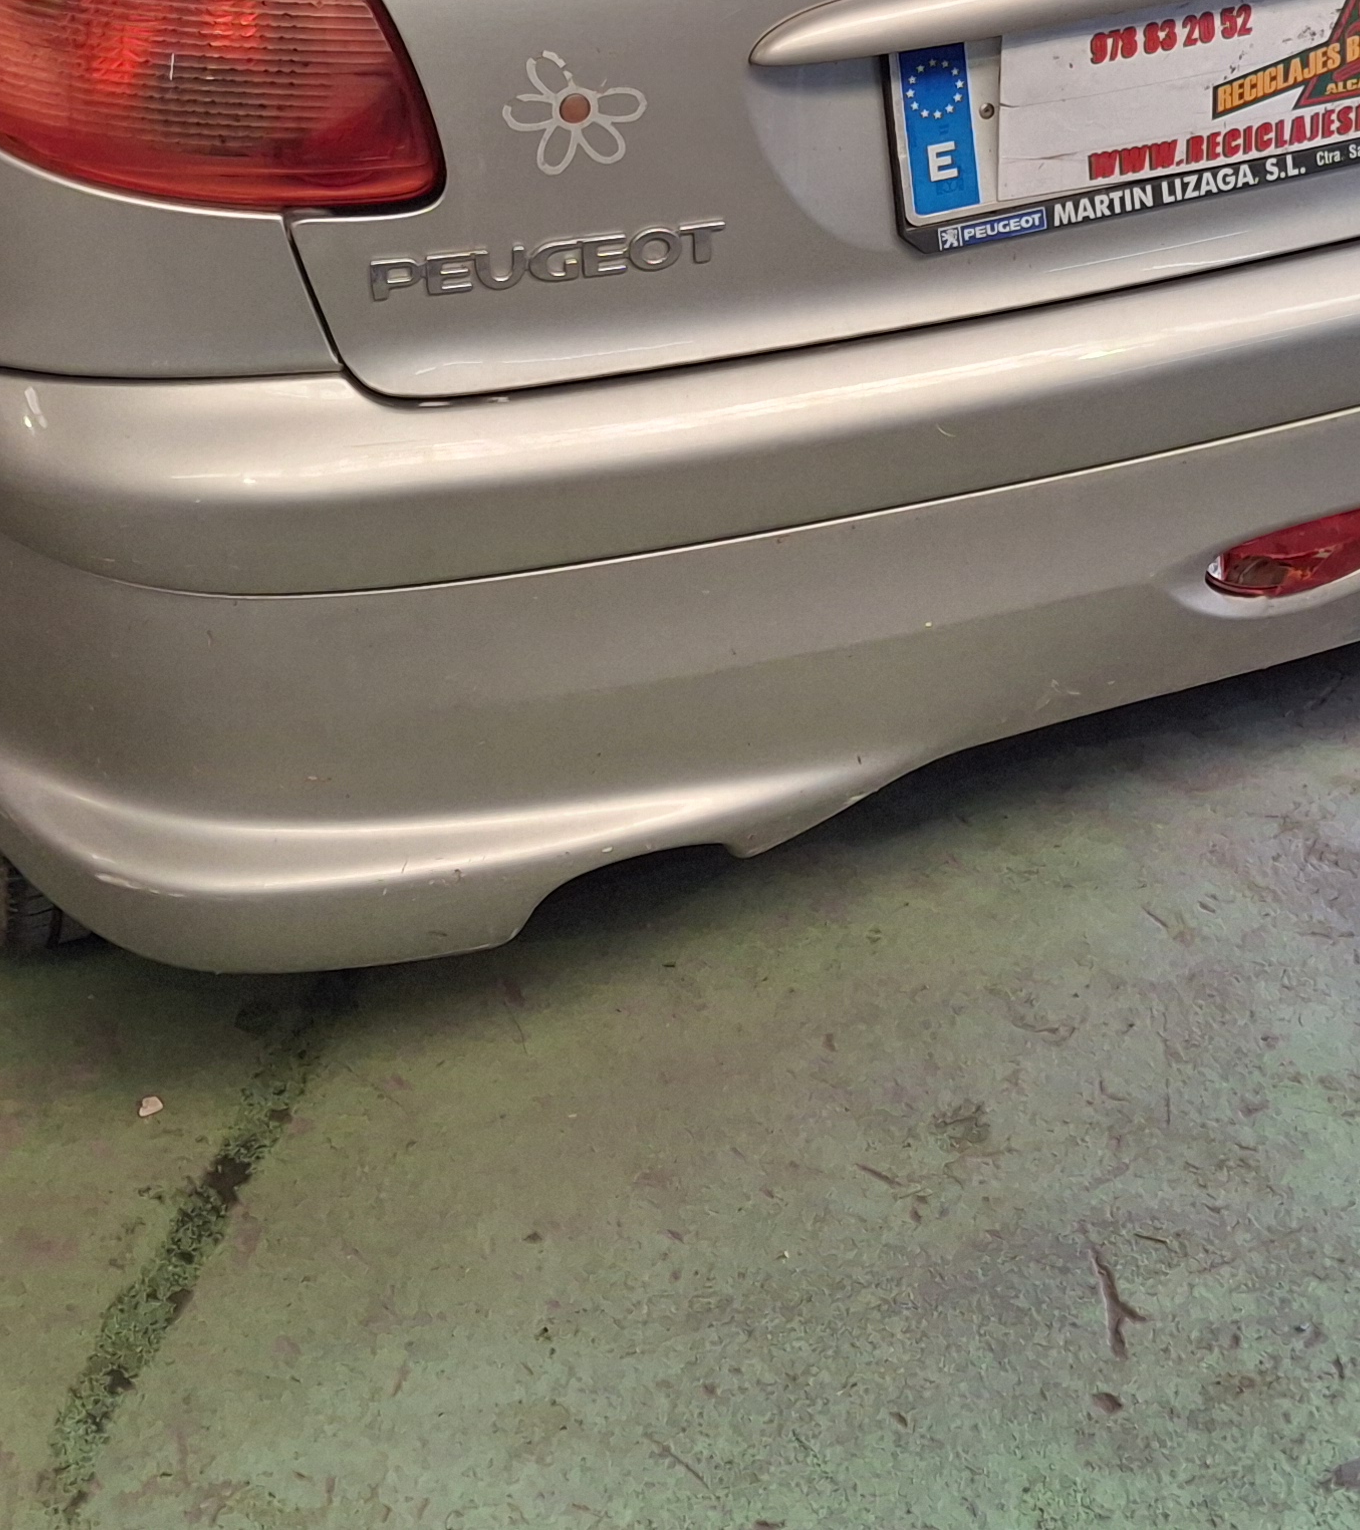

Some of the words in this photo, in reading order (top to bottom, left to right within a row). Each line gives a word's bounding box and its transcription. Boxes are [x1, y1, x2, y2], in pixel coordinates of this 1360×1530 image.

[1090, 26, 1138, 64] 978
[1143, 18, 1178, 55] 83
[1182, 11, 1216, 48] 20
[1220, 3, 1253, 40] 52
[1216, 42, 1341, 113] RECICLAJES
[927, 140, 959, 182] E
[1053, 184, 1154, 227] MARTIN
[1265, 154, 1306, 182] S.L.
[963, 213, 1043, 241] PEUGEOT
[369, 220, 726, 301] PEUGEOT
